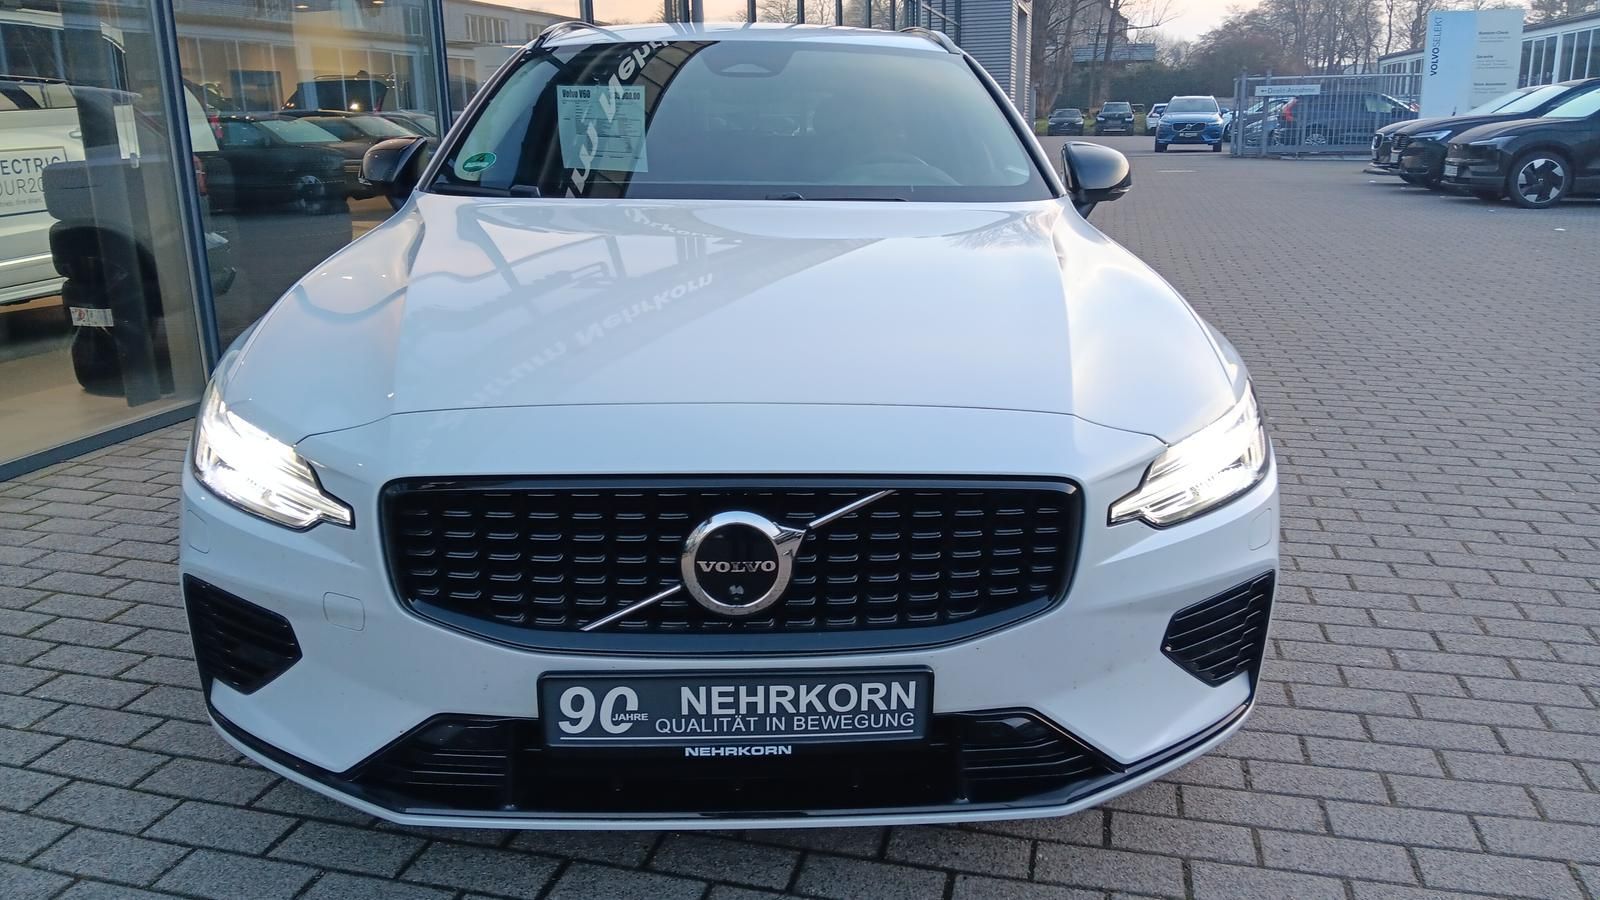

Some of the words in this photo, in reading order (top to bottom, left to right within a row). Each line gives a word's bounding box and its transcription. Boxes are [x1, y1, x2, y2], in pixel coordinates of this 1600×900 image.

[562, 89, 578, 98] Volvo
[579, 89, 591, 98] V60
[697, 560, 777, 573] VOLVO
[680, 681, 916, 716] NEHRKORN
[558, 686, 639, 734] 90
[612, 713, 649, 721] JAHRE
[655, 715, 759, 734] QUALITÄT
[766, 716, 785, 732] IN
[793, 712, 915, 731] BEWEGUNG
[685, 745, 792, 757] NEHRKORN
